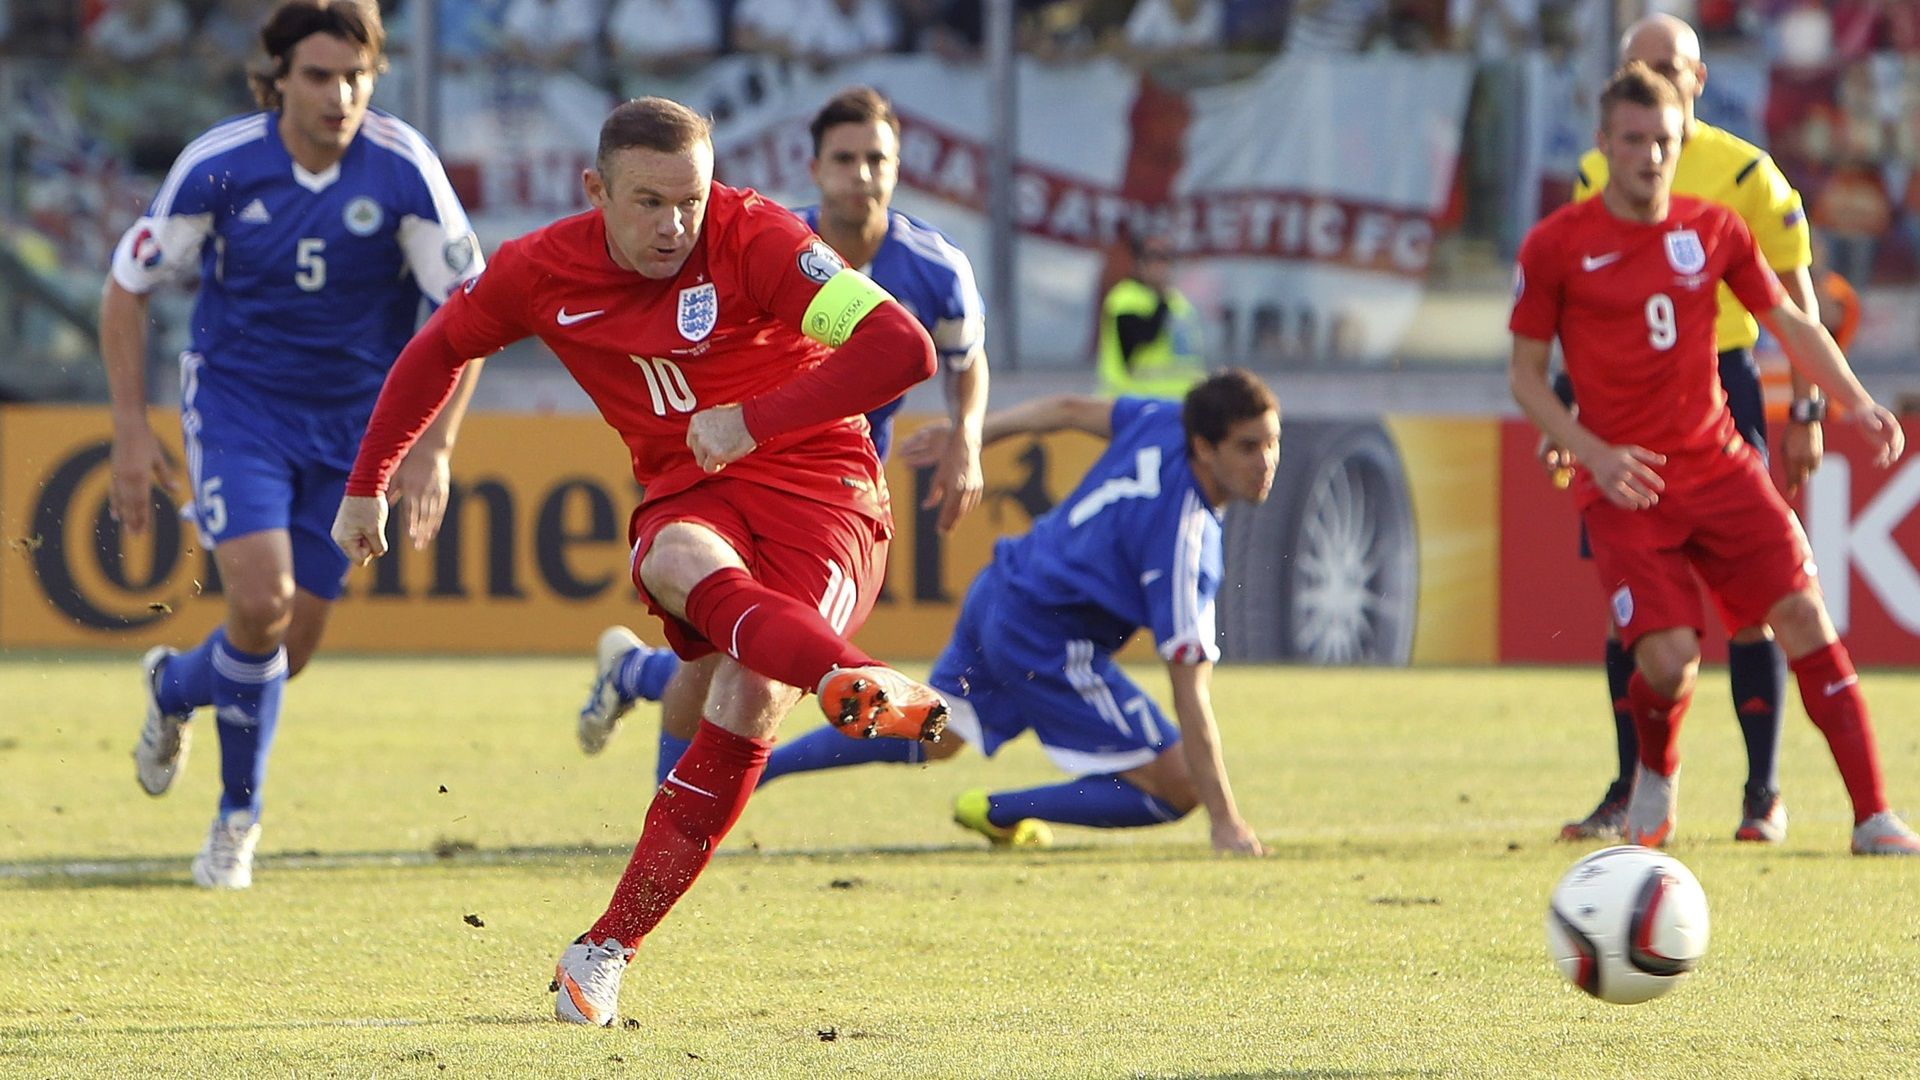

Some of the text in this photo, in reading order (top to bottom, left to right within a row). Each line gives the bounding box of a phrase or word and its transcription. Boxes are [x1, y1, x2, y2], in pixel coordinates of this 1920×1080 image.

[294, 237, 327, 292] 5
[1354, 213, 1433, 271] FC
[834, 299, 864, 338] RACISM
[1645, 292, 1677, 351] 9
[628, 353, 698, 416] 10
[202, 475, 228, 535] 5
[1066, 445, 1163, 529] 7
[818, 558, 858, 637] 10
[1124, 695, 1164, 748] 7
